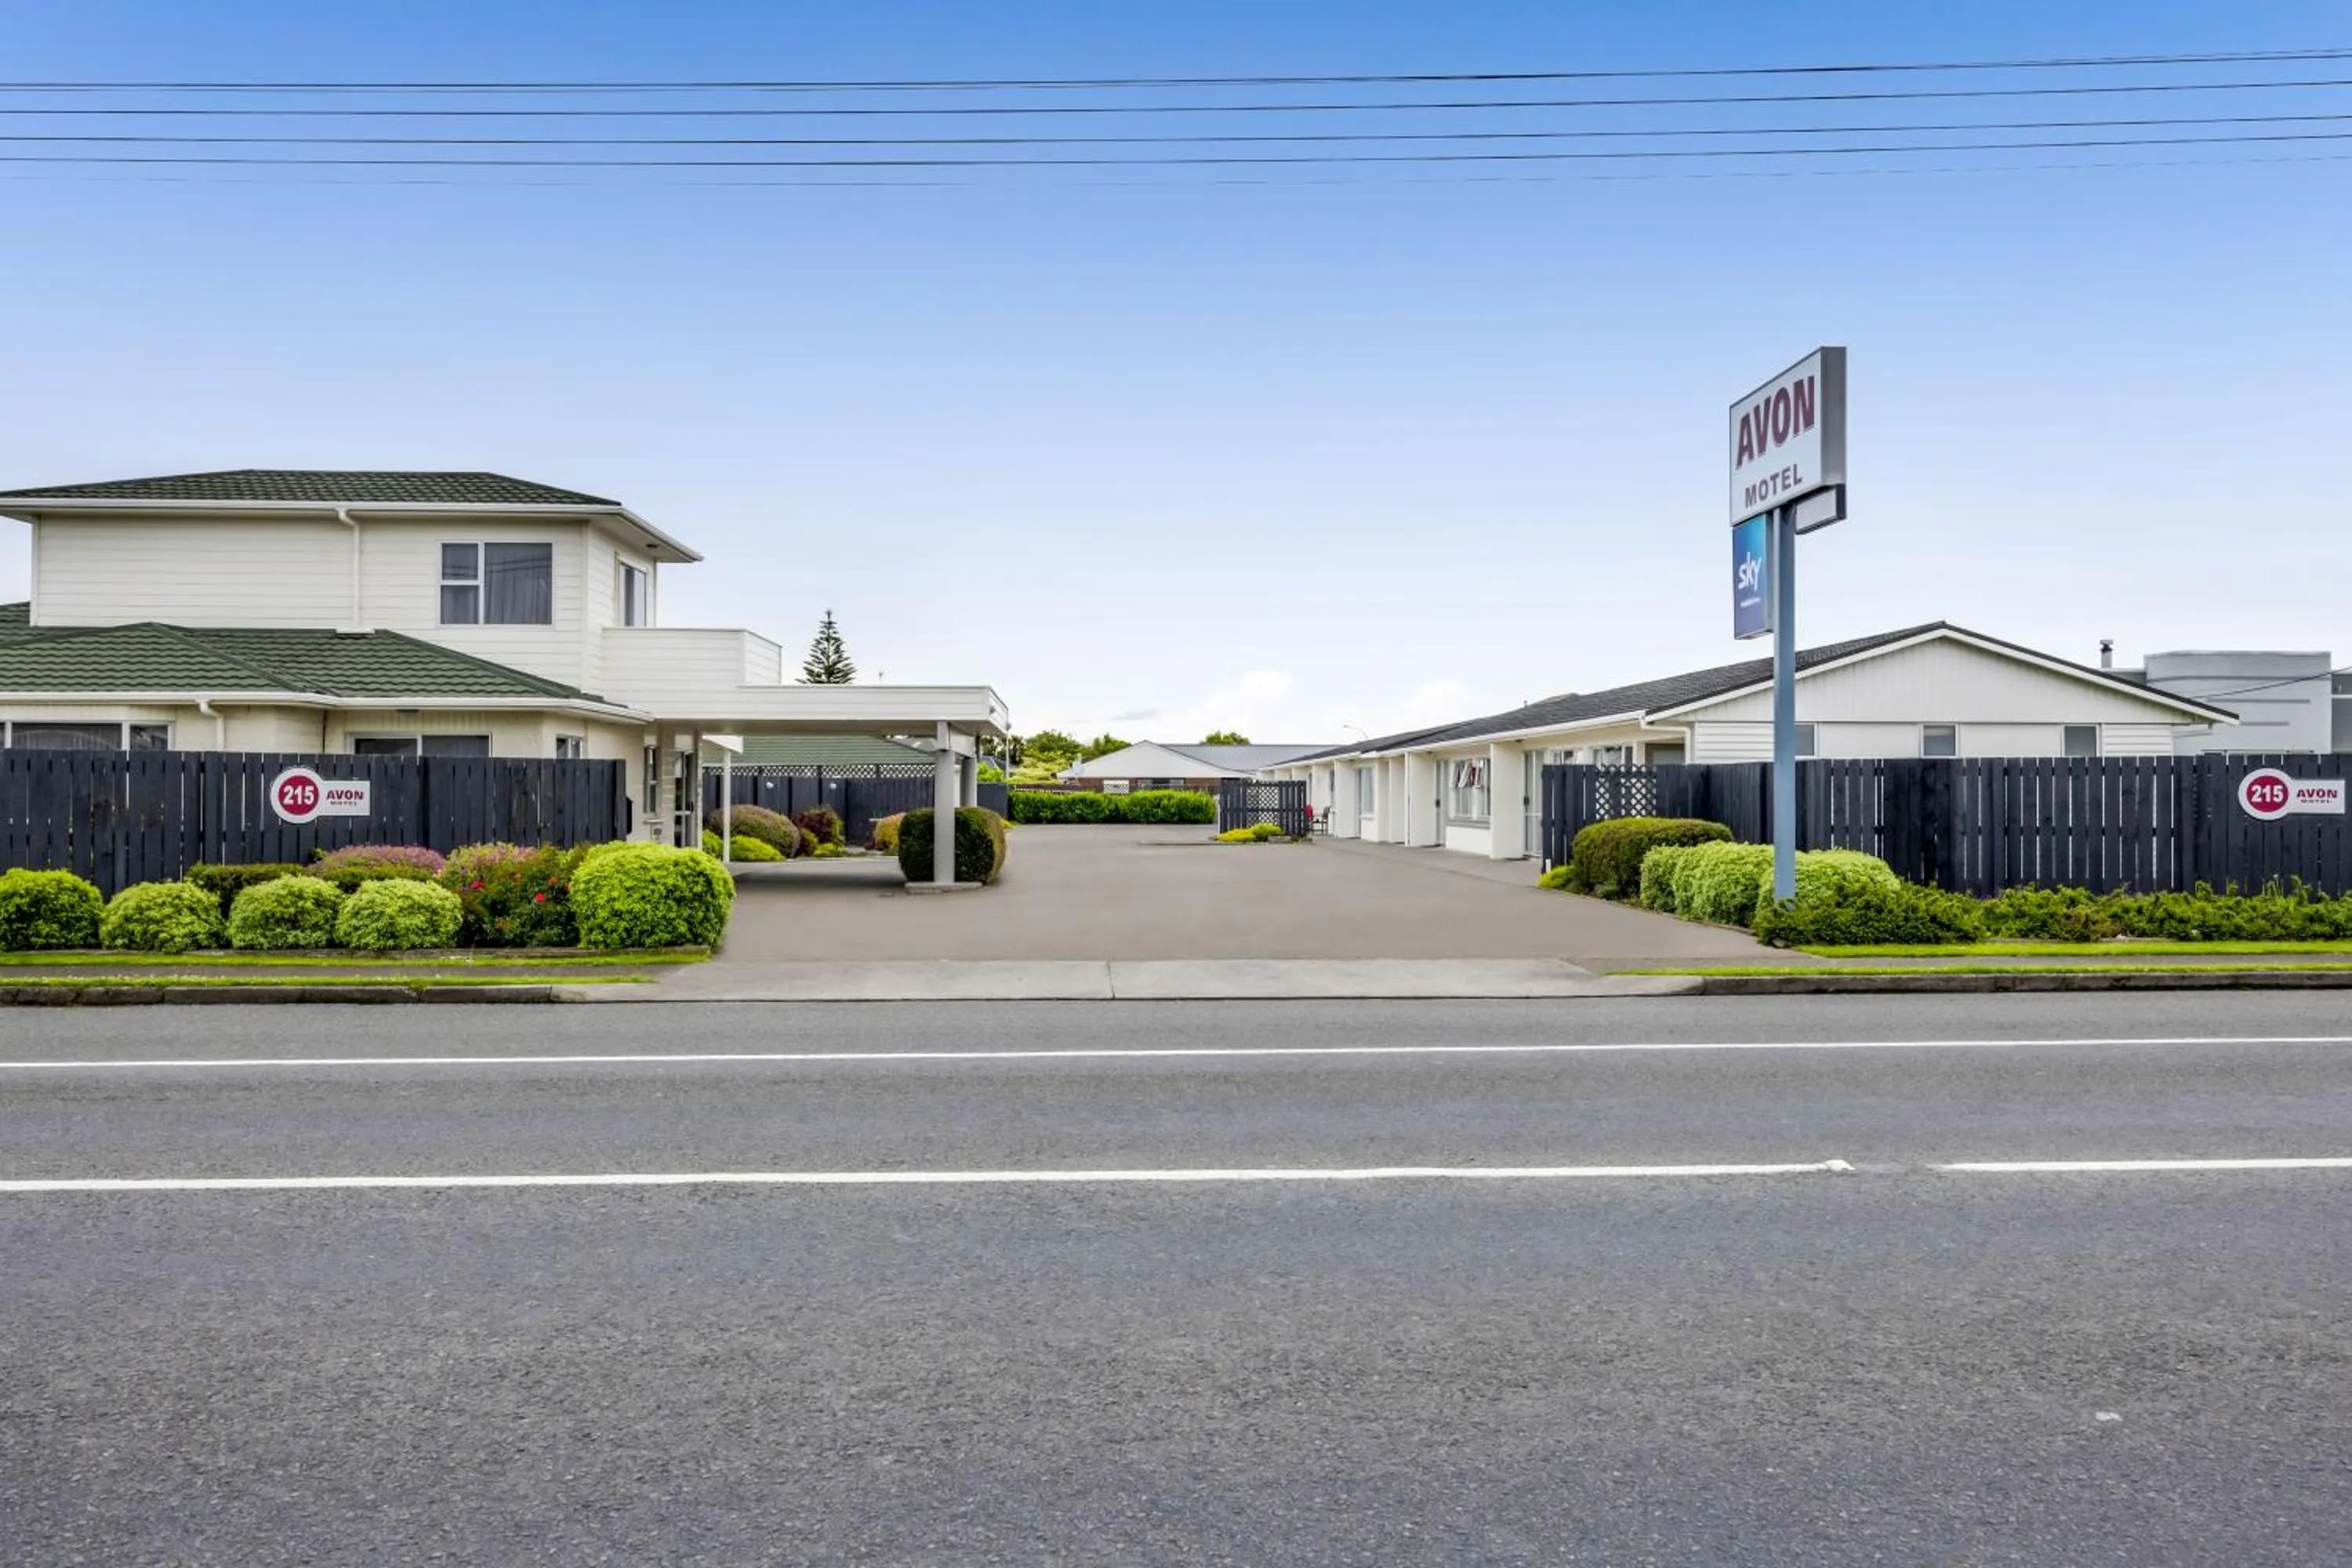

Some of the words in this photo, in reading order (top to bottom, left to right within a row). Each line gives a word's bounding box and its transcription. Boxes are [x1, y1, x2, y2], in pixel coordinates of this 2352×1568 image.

[1736, 376, 1815, 470] AVON
[1744, 463, 1802, 509] MOTEL
[1738, 551, 1762, 590] sky
[283, 785, 314, 805] 215
[326, 789, 364, 800] AVON
[2251, 785, 2284, 803] 215
[2296, 788, 2338, 798] AVON
